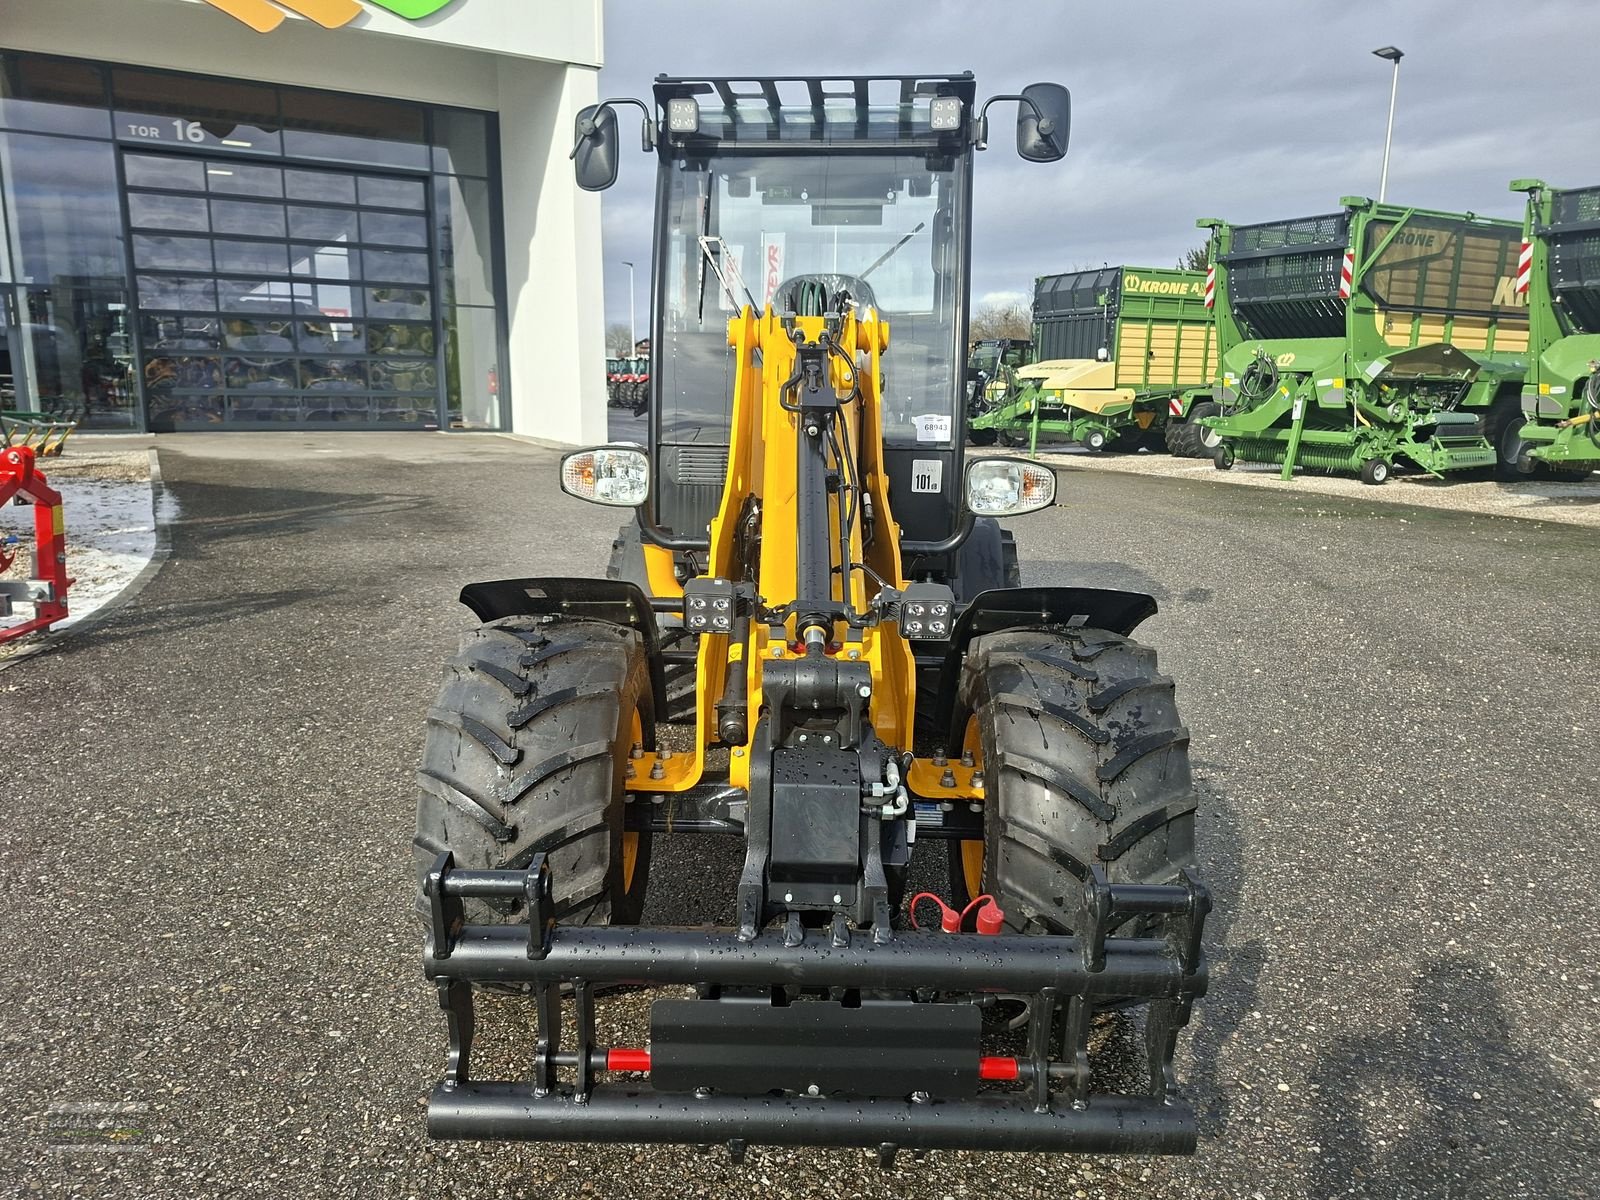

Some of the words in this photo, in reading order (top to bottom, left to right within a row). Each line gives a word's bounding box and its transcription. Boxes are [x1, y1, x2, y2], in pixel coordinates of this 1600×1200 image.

[127, 124, 160, 138] TOR
[172, 120, 205, 143] 16
[1391, 230, 1435, 247] RONE
[1140, 280, 1189, 295] KRONE
[924, 423, 948, 431] 68943
[915, 474, 931, 490] 101
